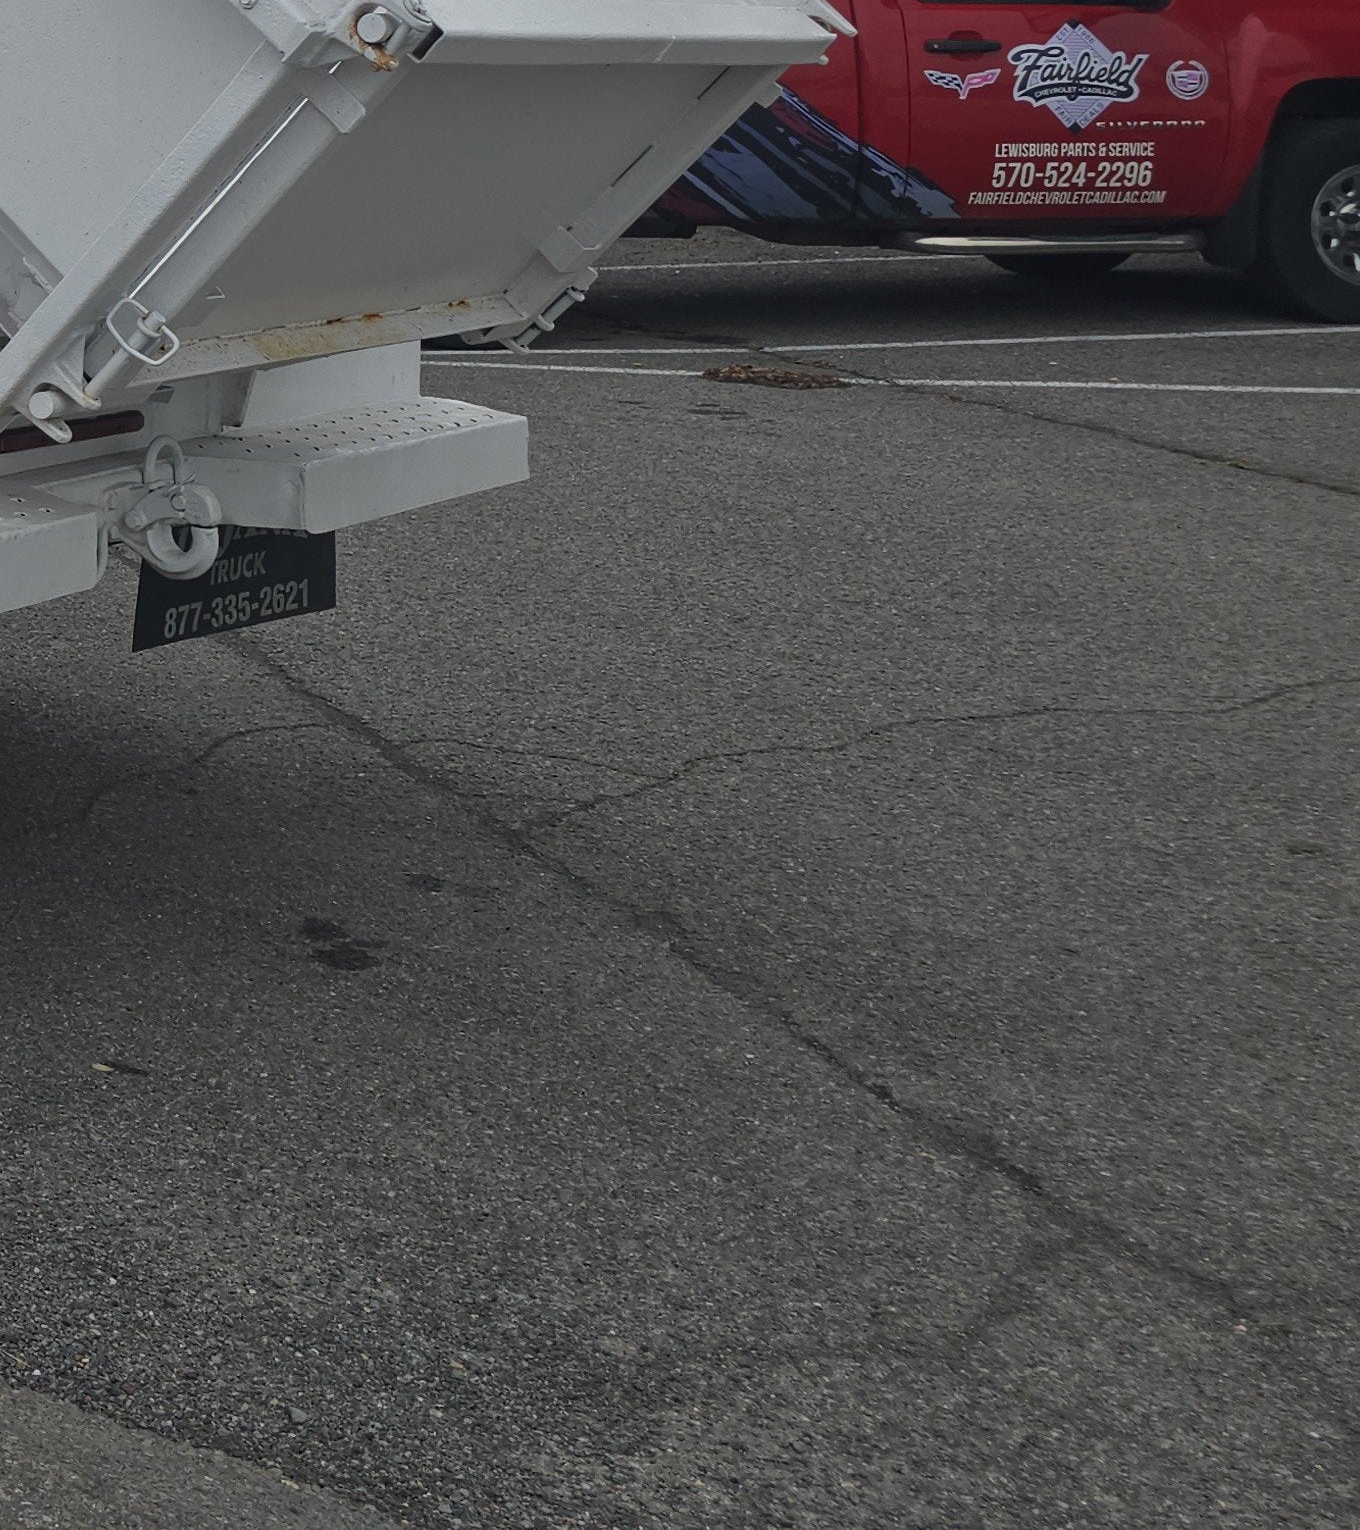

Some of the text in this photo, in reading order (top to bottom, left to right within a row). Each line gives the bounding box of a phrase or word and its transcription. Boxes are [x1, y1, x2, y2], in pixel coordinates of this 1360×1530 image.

[1010, 46, 1143, 93] Fairfield
[1034, 86, 1118, 98] CHEVROLET CADILLAC
[995, 142, 1155, 158] LEWISBURG PARTS & SERVICE
[991, 161, 1154, 188] 570-524-2296
[968, 190, 1166, 205] FAIRFIELDCHEVROLETCADILLAC.COM
[210, 550, 268, 586] TRUCK
[163, 578, 309, 639] 877-335-2621
